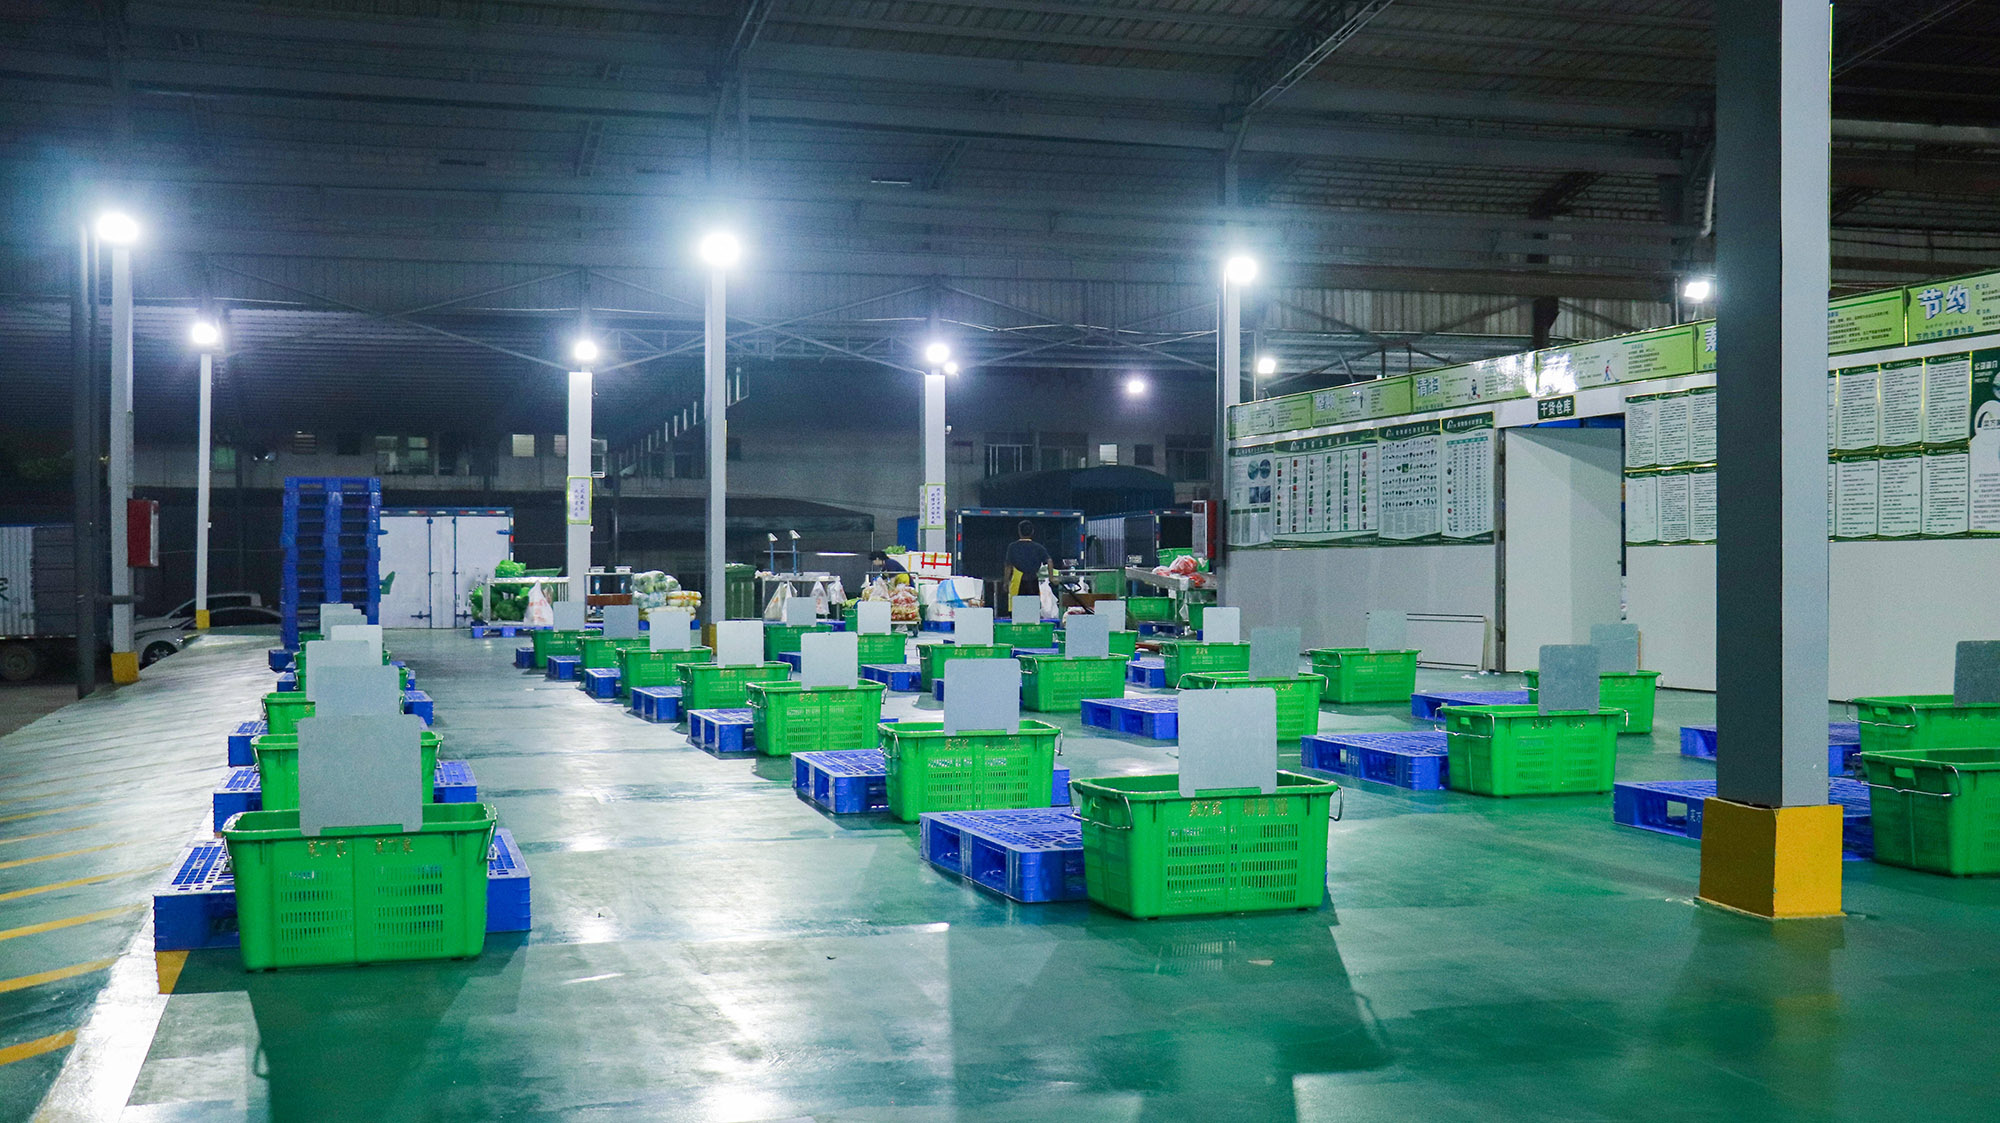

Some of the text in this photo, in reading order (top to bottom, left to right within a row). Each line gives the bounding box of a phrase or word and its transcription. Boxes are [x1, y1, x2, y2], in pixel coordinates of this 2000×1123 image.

[1917, 283, 1971, 320] 节约
[1540, 398, 1572, 417] 干货仓库
